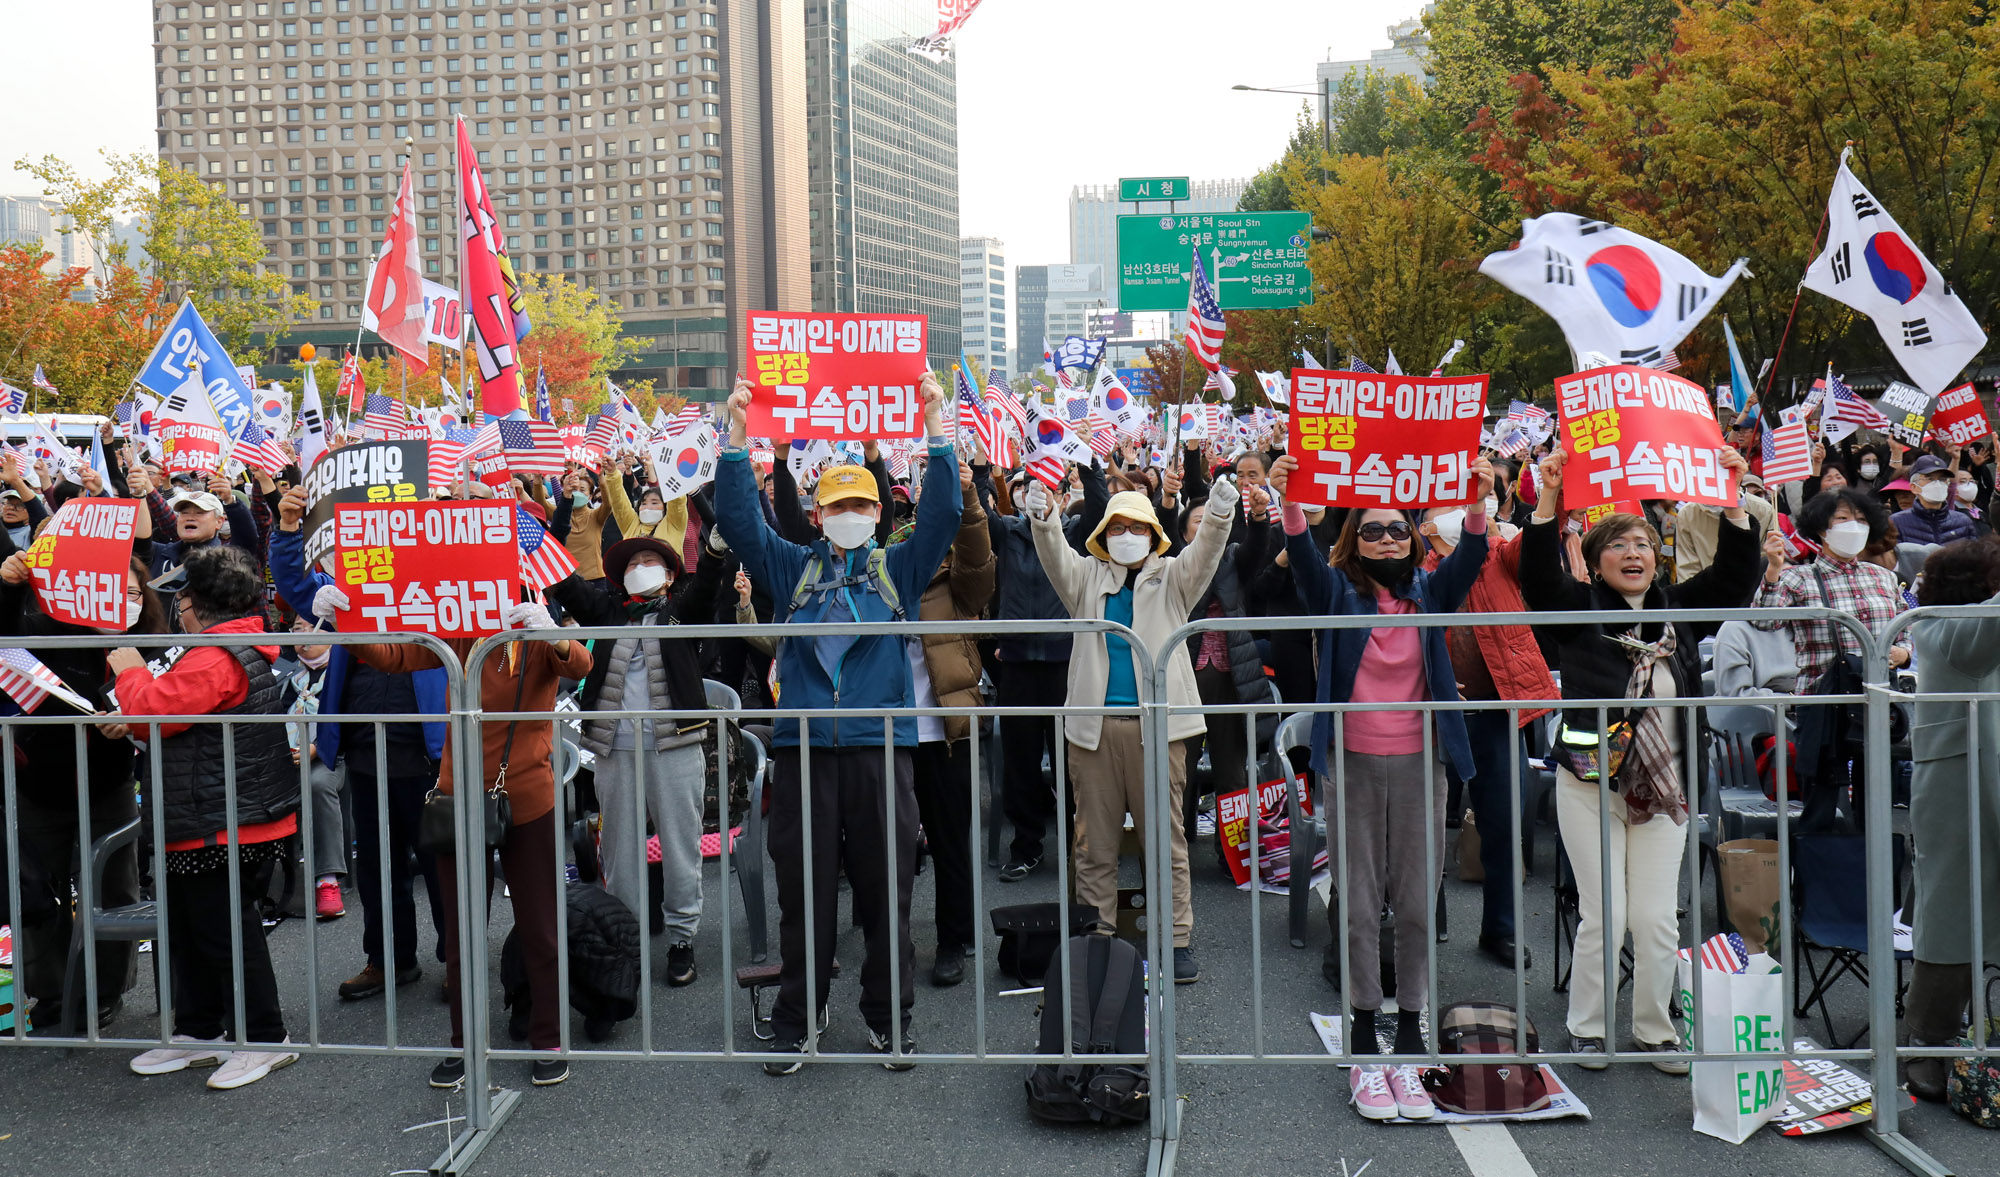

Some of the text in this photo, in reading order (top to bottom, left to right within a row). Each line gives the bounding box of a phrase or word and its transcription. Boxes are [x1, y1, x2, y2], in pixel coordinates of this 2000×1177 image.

[1137, 181, 1174, 196] 시청
[1178, 216, 1214, 228] 서울역
[1178, 233, 1214, 246] 숭례문
[1218, 219, 1261, 227] Seoul Stn
[1218, 239, 1268, 248] Sungnyemun
[1252, 249, 1307, 260] 신촌로터리
[1123, 263, 1180, 276] 남산3호터널
[1124, 277, 1144, 285] Namsan
[1165, 276, 1180, 285] Tunnel
[1252, 261, 1281, 269] Sinchon
[1252, 274, 1296, 286] 덕수궁길
[1252, 287, 1294, 296] Deoksugung
[752, 317, 922, 353] 문재인·이재명
[755, 352, 811, 386] 당장
[772, 385, 919, 434] 구속하라
[1296, 375, 1483, 421] 문재인·이재명
[1560, 371, 1714, 421] 문재인·이재명
[1936, 385, 1976, 412] 이재명
[1298, 416, 1357, 451] 당장
[1568, 408, 1621, 454] 당장
[1314, 450, 1472, 504] 구속하라
[1589, 441, 1730, 500] 구속하라
[40, 503, 136, 541] 재인·이재명
[339, 506, 512, 547] 문재인·이재명
[1586, 503, 1616, 523] 당장
[304, 518, 336, 571] 전교조
[342, 546, 395, 585] 당장
[32, 567, 123, 624] 구속하라
[361, 579, 514, 633] 구속하라
[1734, 1015, 1784, 1052] RE:
[1737, 1068, 1785, 1116] EAR
